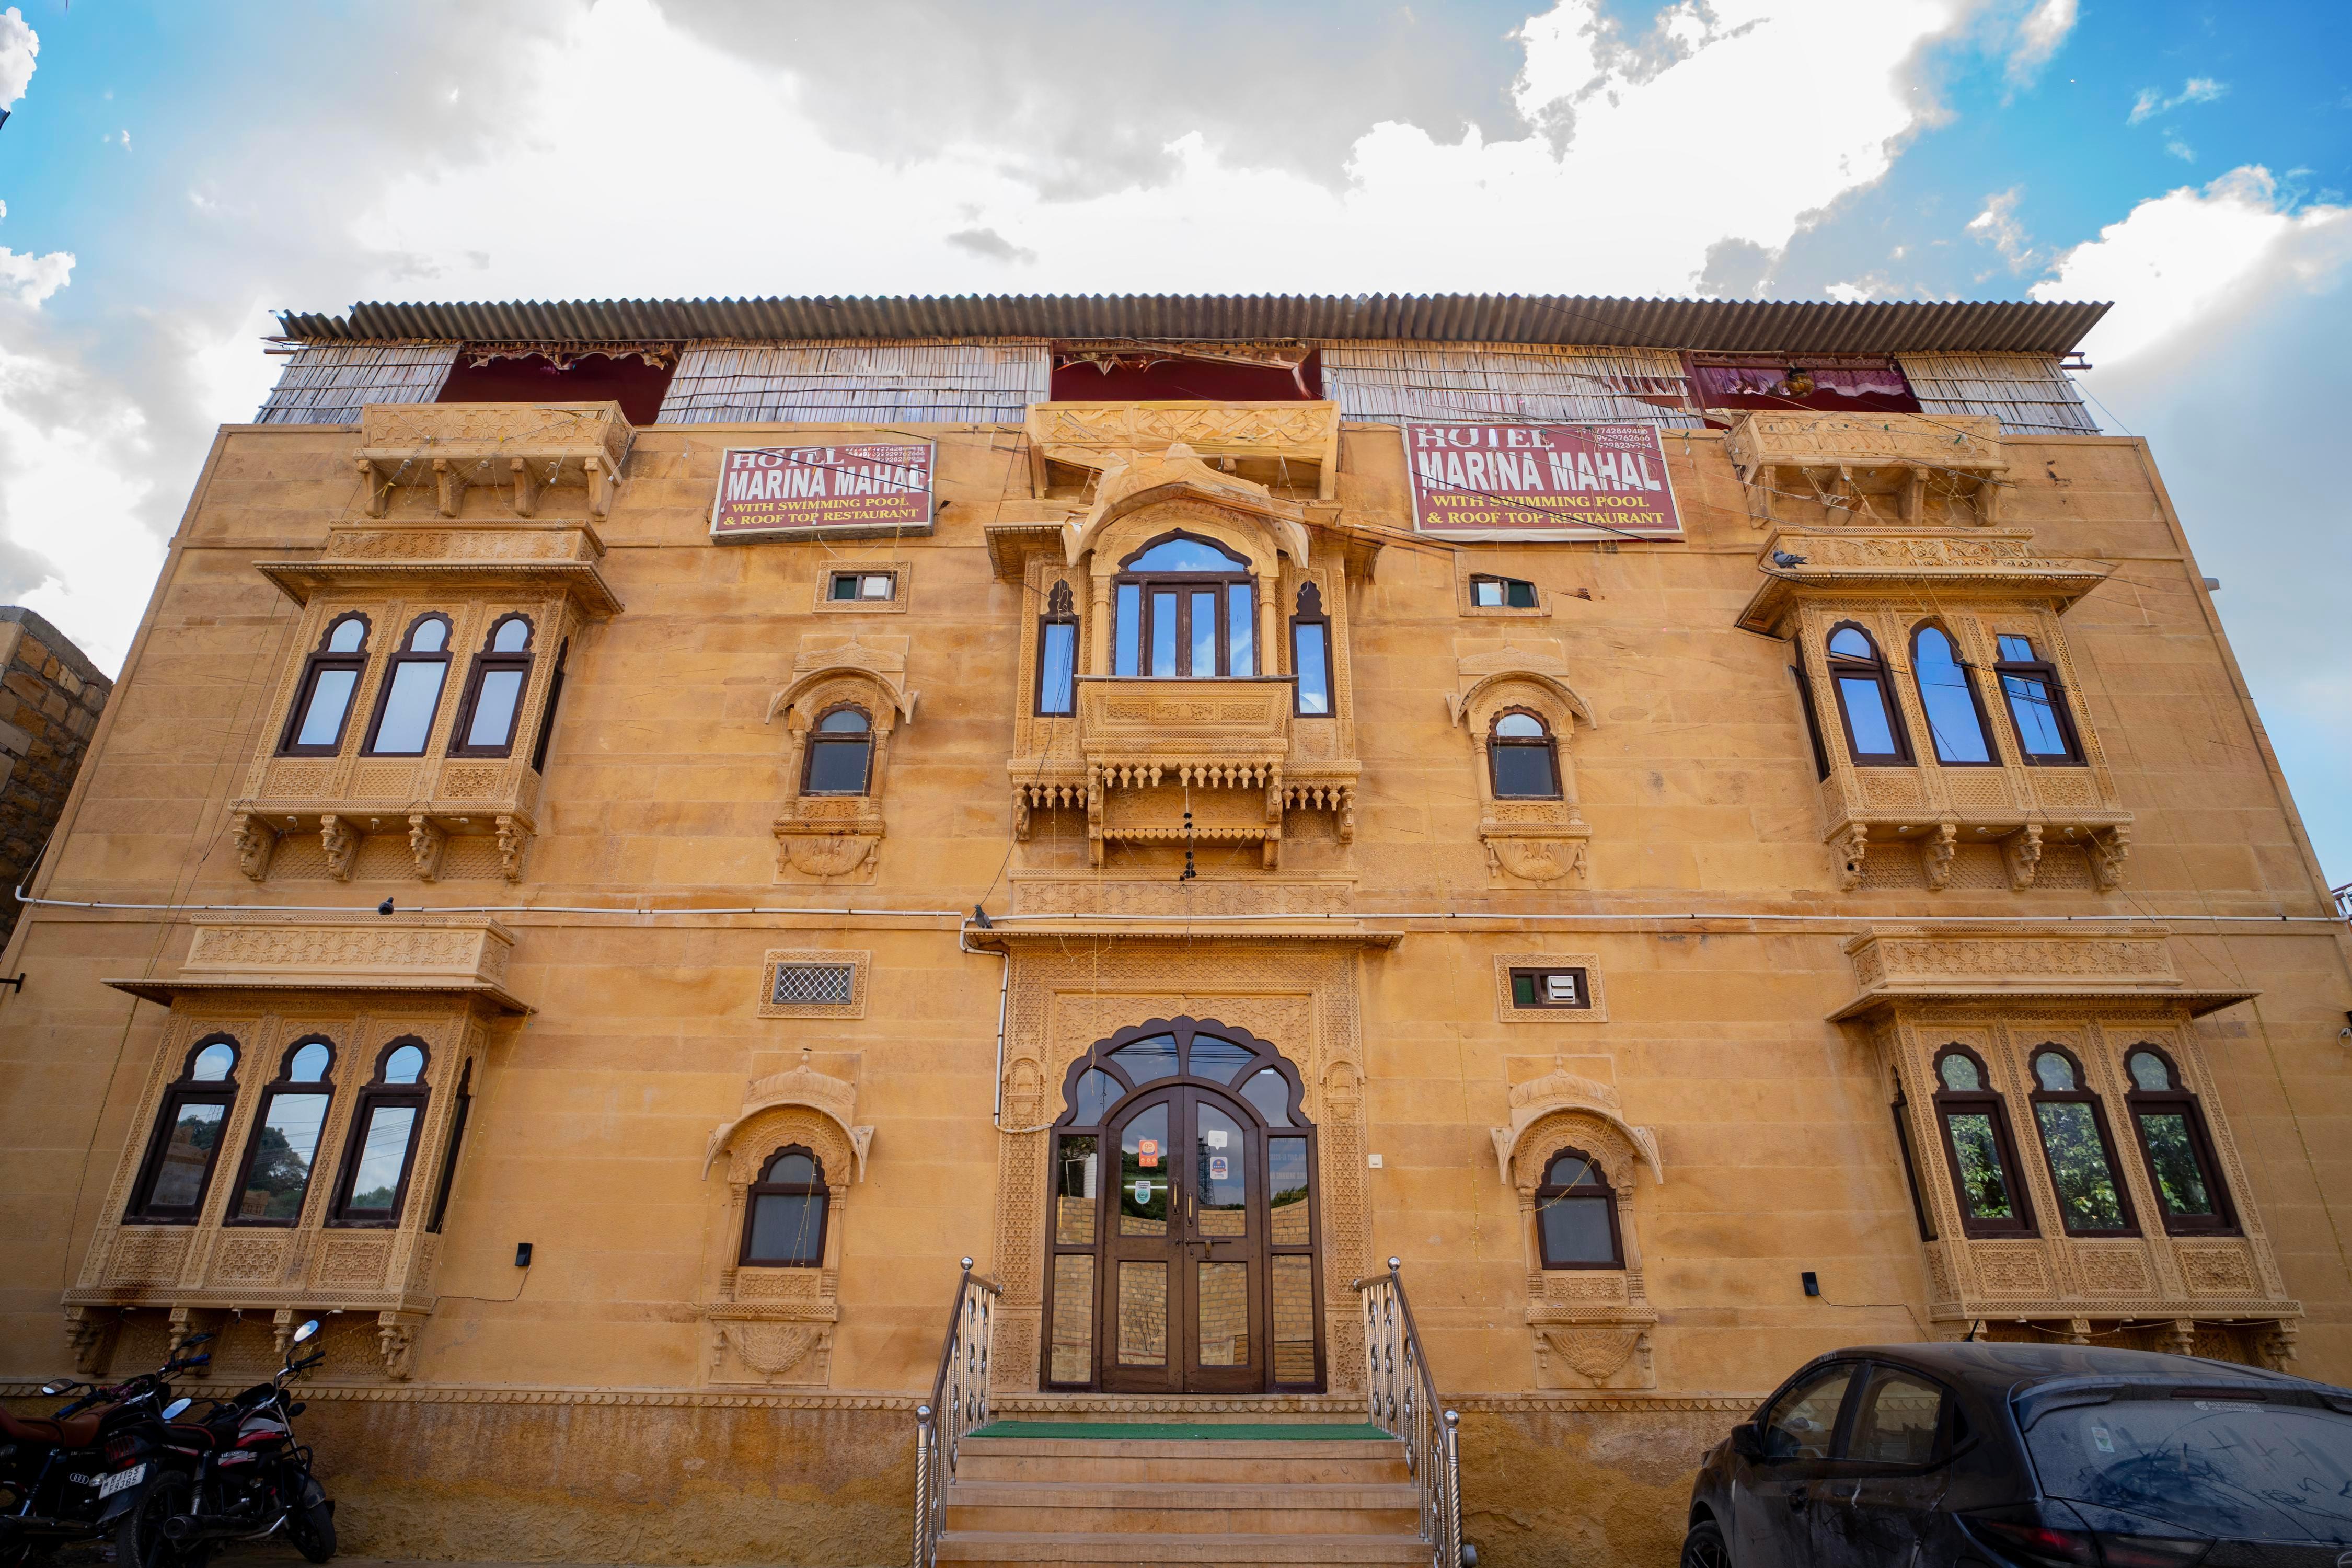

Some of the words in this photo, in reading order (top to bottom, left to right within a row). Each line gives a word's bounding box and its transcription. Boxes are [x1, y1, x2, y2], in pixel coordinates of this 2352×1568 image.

[1415, 428, 1555, 448] HOTEL
[1417, 451, 1544, 490] MARINA
[1548, 452, 1662, 491] MAHAL
[727, 468, 826, 501] MARINA
[834, 464, 924, 496] MAHAL
[732, 503, 774, 513] WITH
[778, 498, 860, 511] SWIMMING
[865, 496, 909, 507] POOL
[1432, 495, 1484, 506] WITH
[1490, 495, 1590, 507] SWIMMING
[1597, 496, 1650, 507] POOL
[724, 516, 736, 525] &
[740, 514, 785, 525] ROOF
[788, 513, 820, 522] TOP
[823, 509, 919, 521] RESTAURANT
[1427, 512, 1443, 523] &
[1447, 512, 1501, 523] ROOF
[1505, 512, 1544, 523] TOP
[1547, 512, 1664, 523] RESTAURANT
